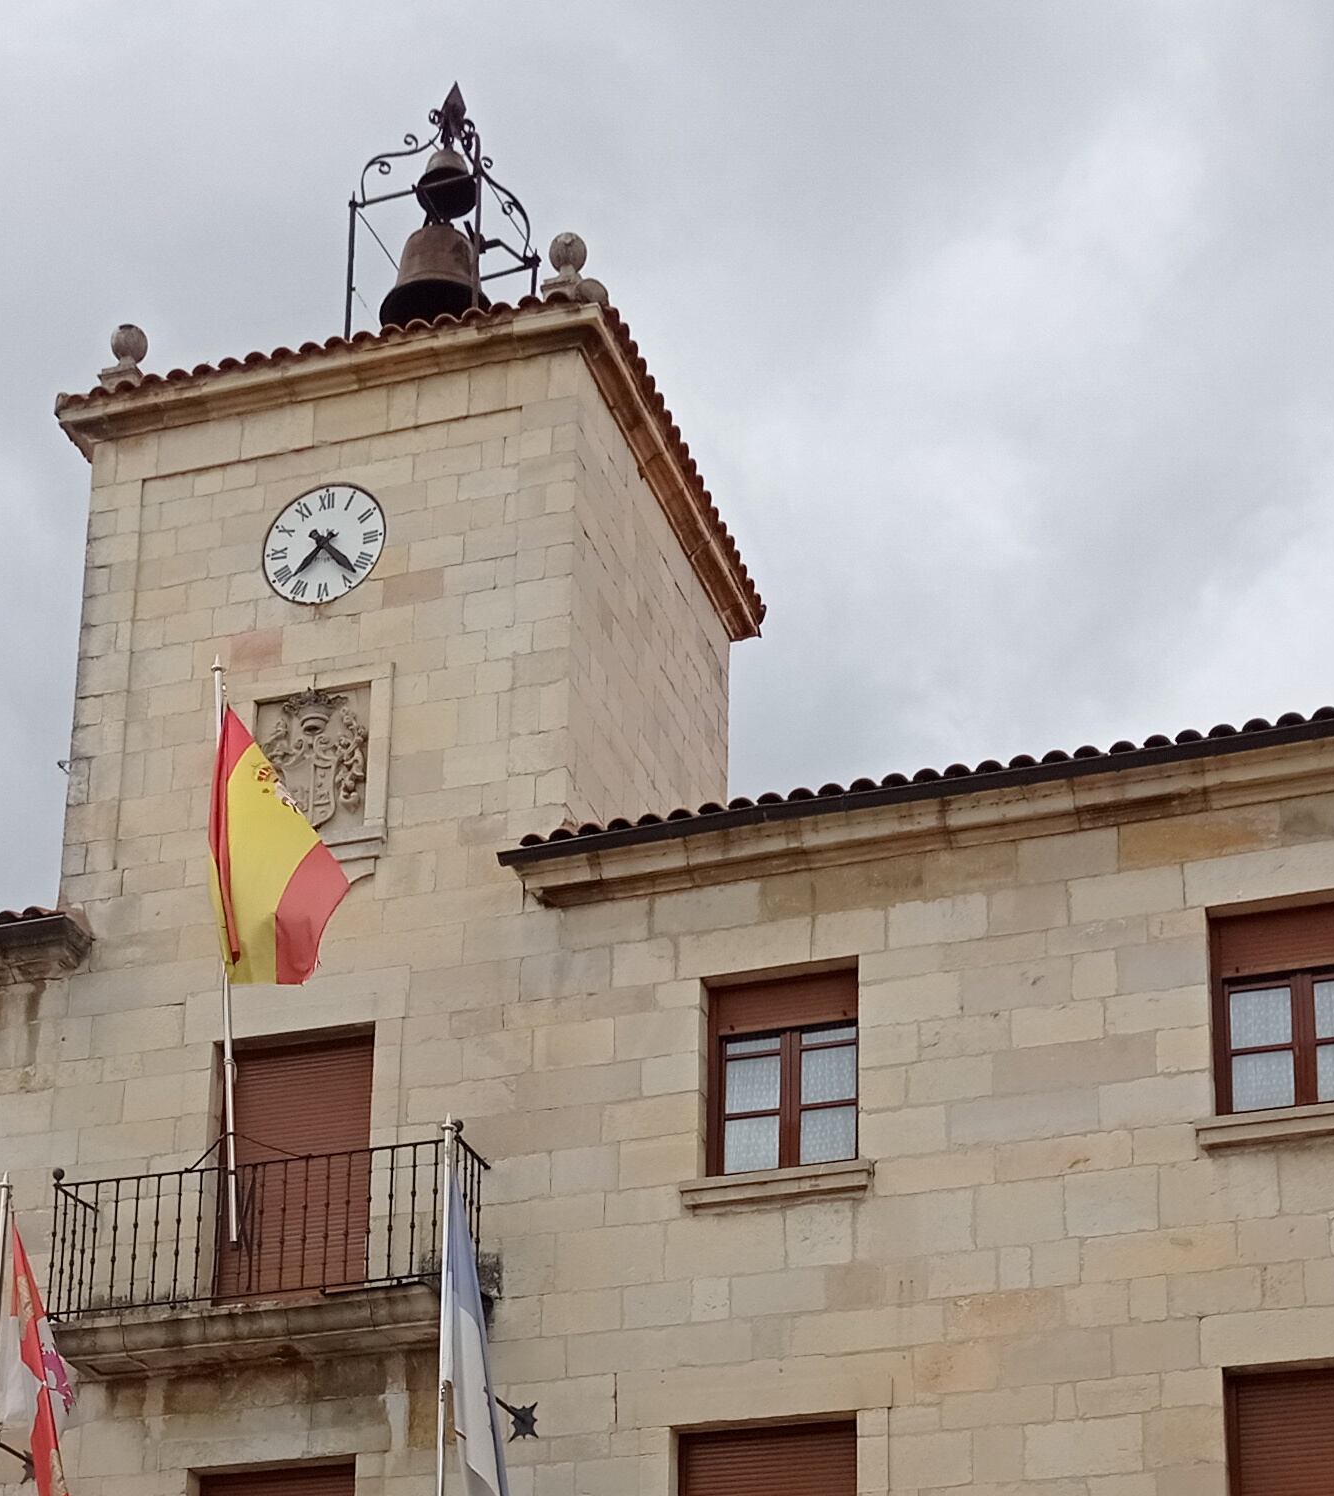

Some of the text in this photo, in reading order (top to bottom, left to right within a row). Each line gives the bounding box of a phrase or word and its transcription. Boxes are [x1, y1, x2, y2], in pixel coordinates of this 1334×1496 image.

[318, 492, 336, 511] XII
[344, 494, 355, 511] I
[295, 503, 313, 522] XI
[357, 508, 374, 524] II
[278, 525, 296, 537] X
[362, 529, 379, 545] III
[270, 547, 288, 561] IX
[290, 579, 308, 598] VII
[342, 574, 353, 587] V
[317, 582, 329, 599] VI
